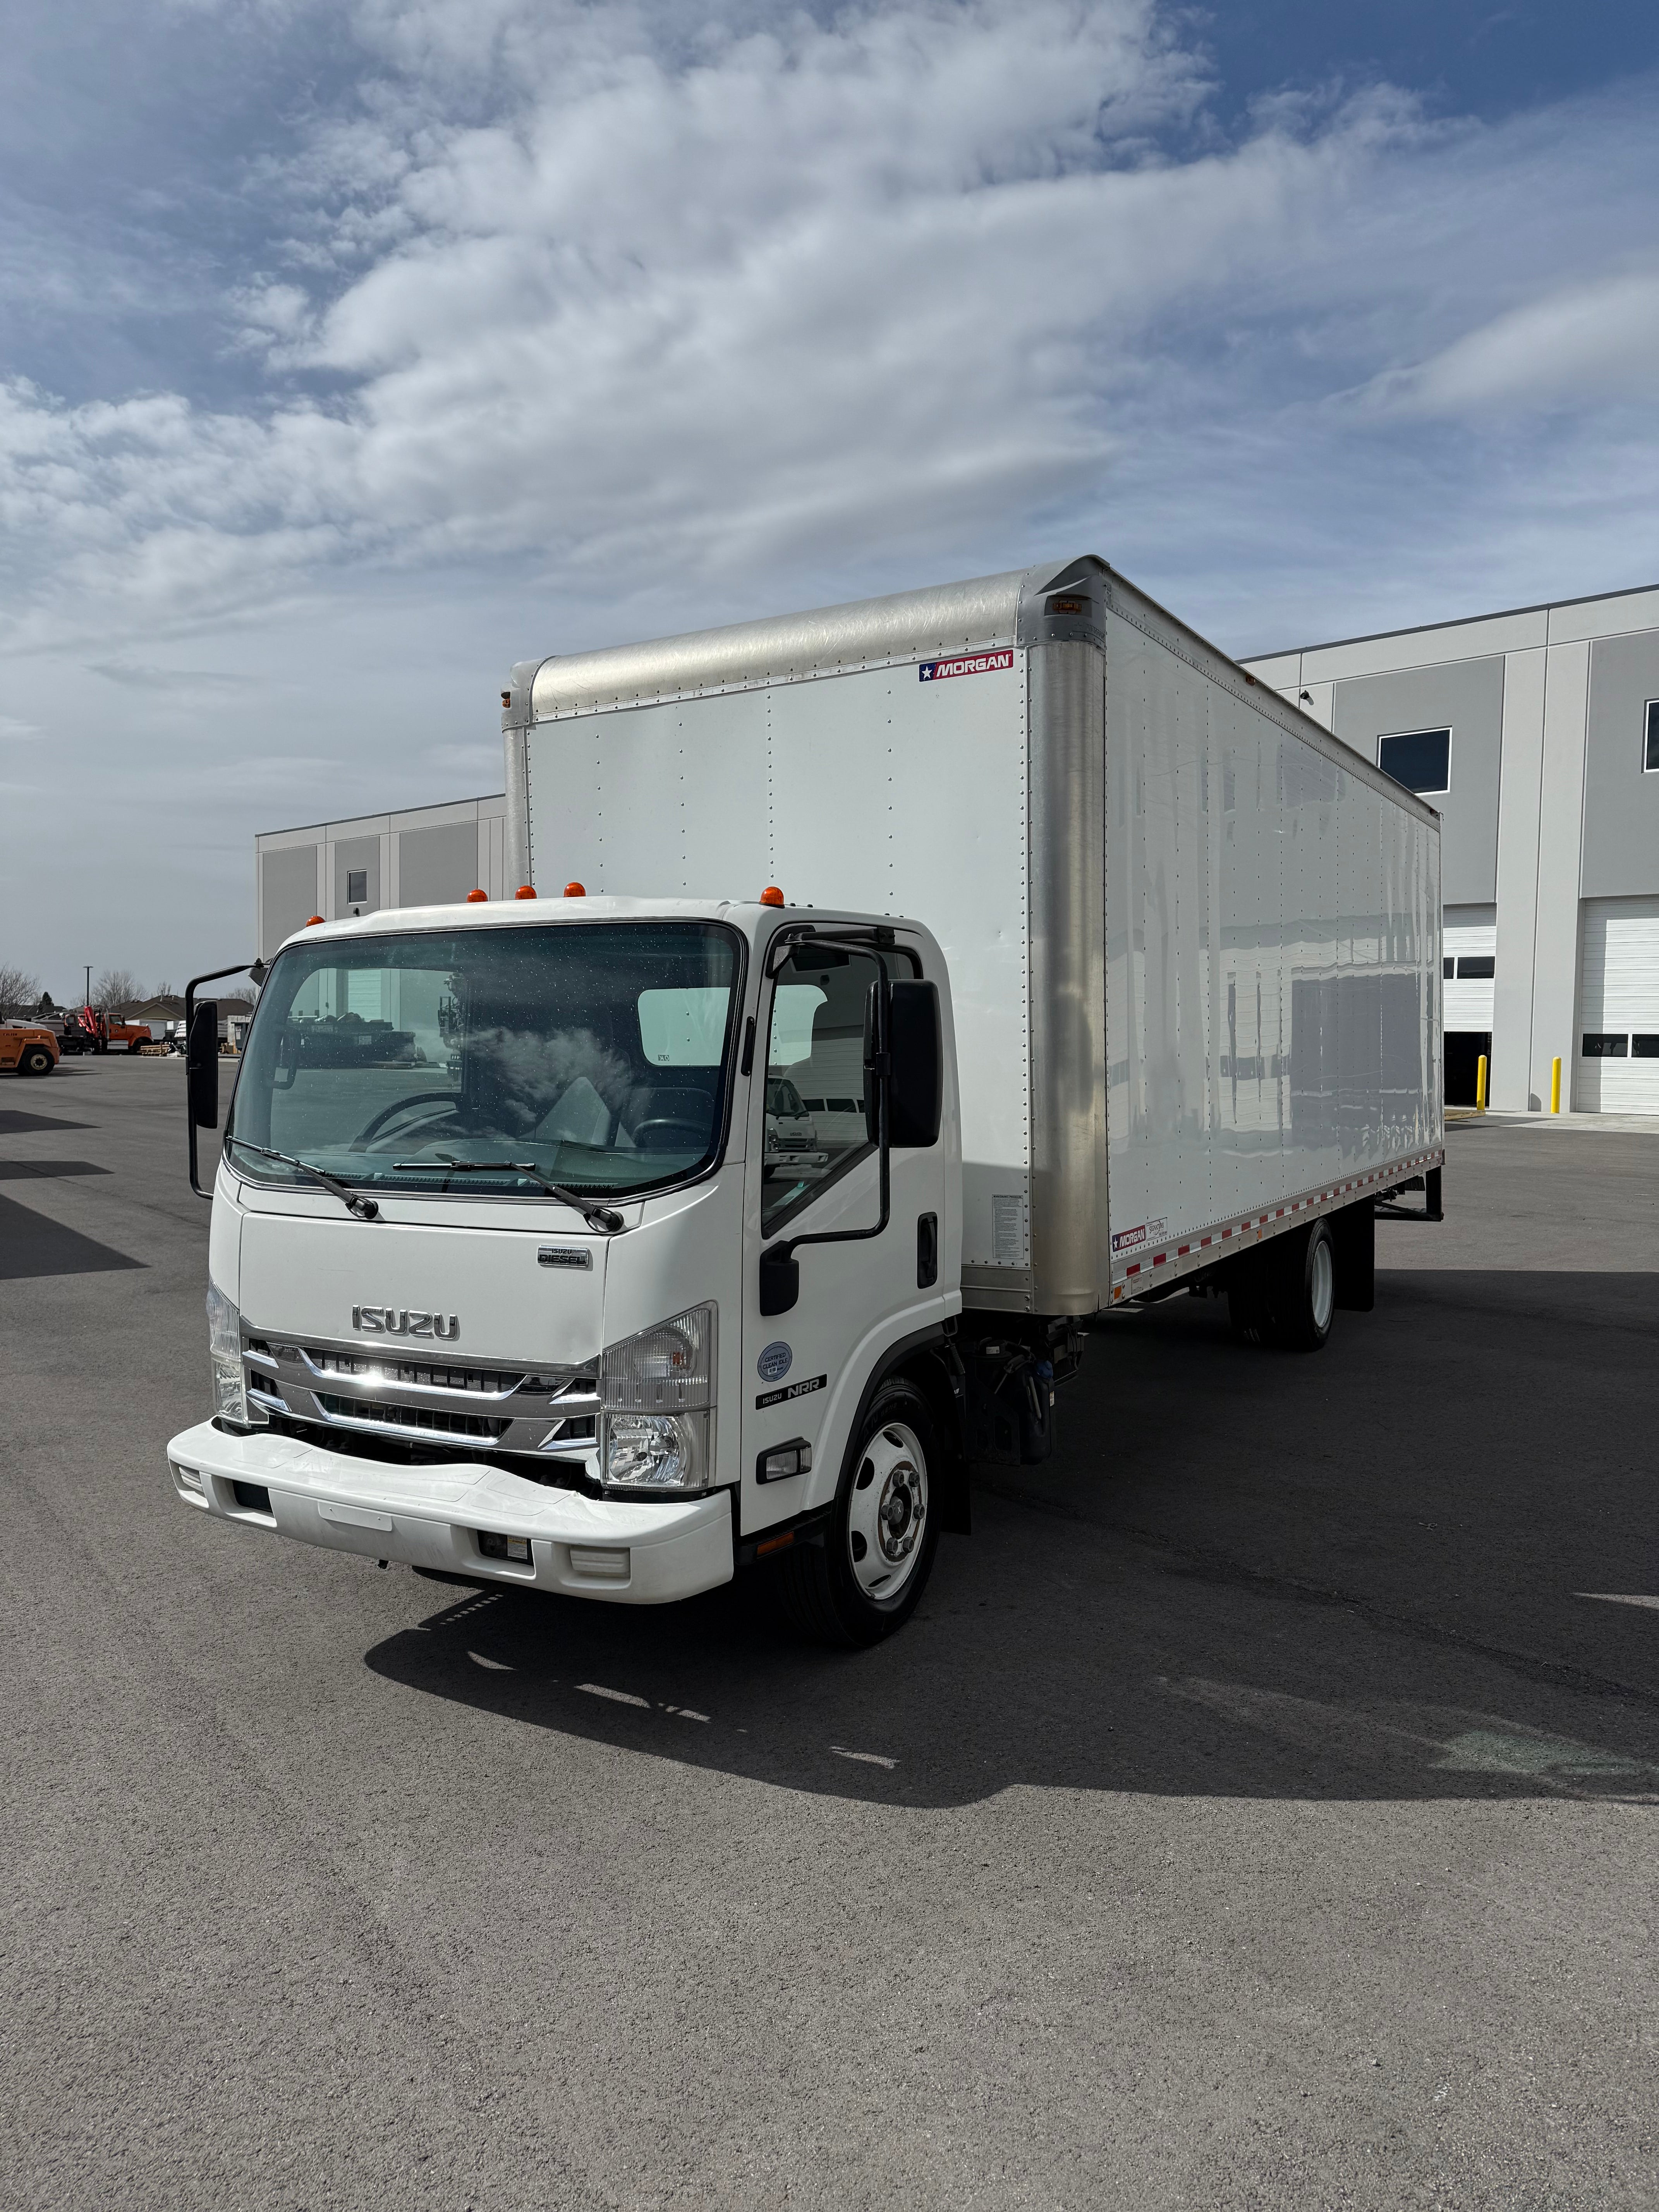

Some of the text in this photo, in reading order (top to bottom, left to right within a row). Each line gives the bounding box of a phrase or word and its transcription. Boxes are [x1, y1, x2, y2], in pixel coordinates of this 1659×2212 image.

[936, 654, 1009, 677] MORGAN
[1119, 1228, 1145, 1248] MORGAN
[539, 1254, 587, 1264] DIESEL
[352, 1305, 457, 1339] ISUZU
[763, 1361, 777, 1369] CLEAN
[765, 1352, 786, 1362] CERTIFIED
[763, 1379, 819, 1405] ISUZU NRR
